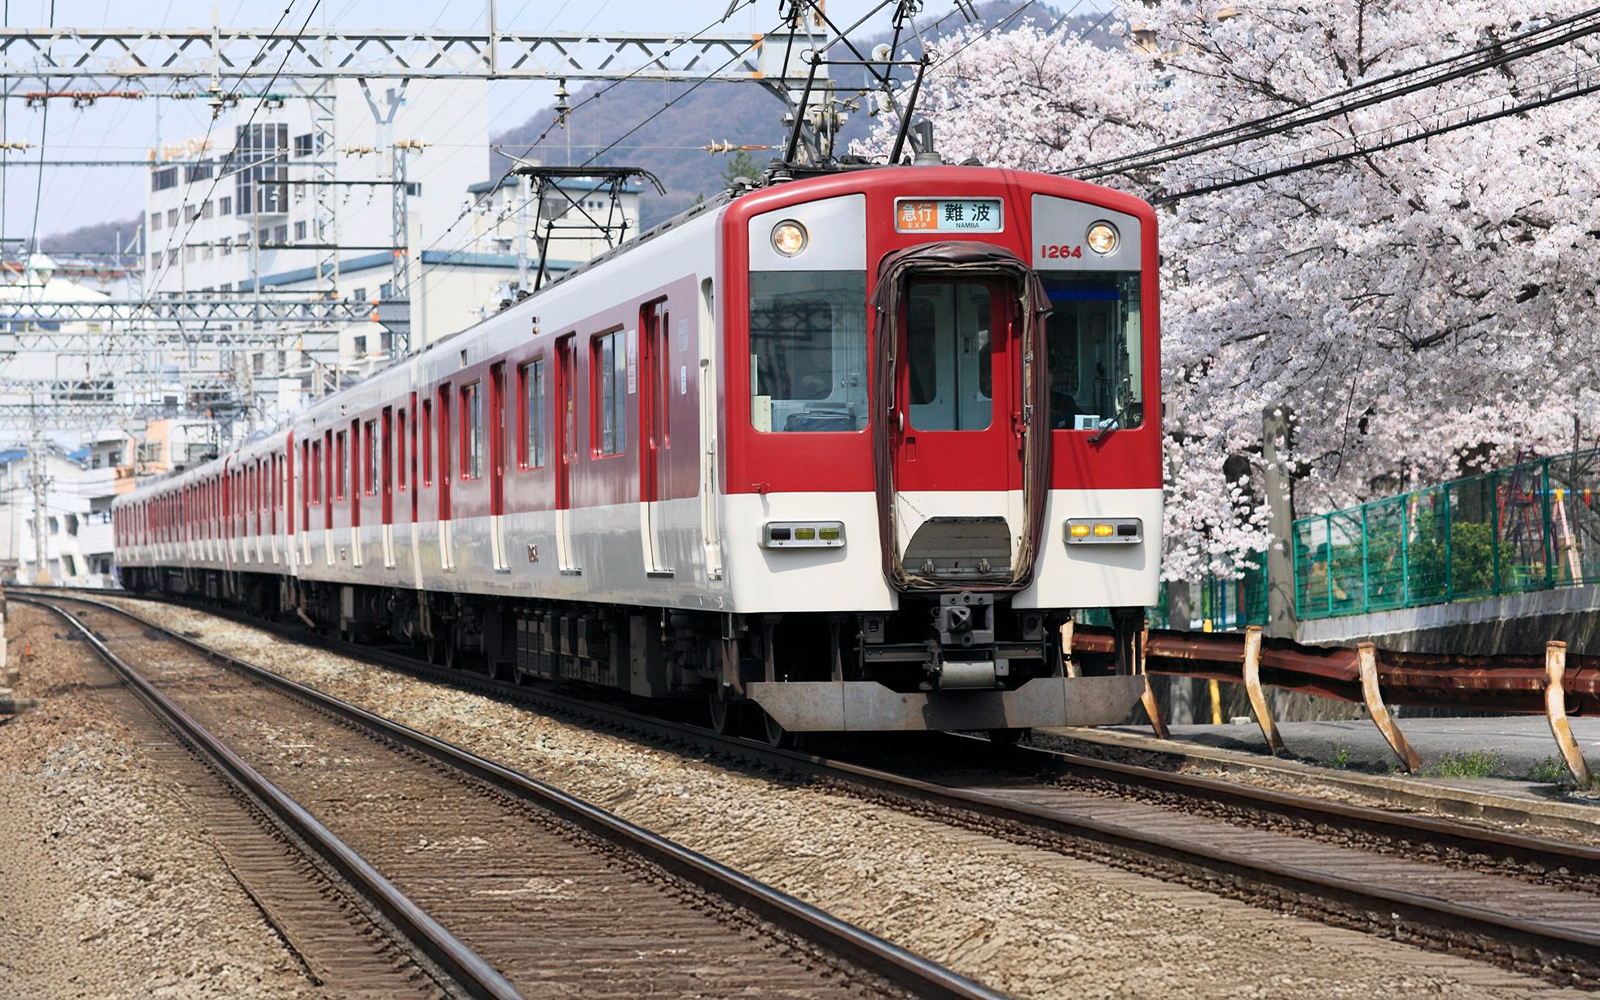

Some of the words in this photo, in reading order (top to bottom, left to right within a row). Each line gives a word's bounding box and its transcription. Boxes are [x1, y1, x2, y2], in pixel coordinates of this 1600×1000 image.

[902, 203, 932, 222] 急行
[944, 203, 990, 221] 難波
[1041, 244, 1082, 259] 1264
